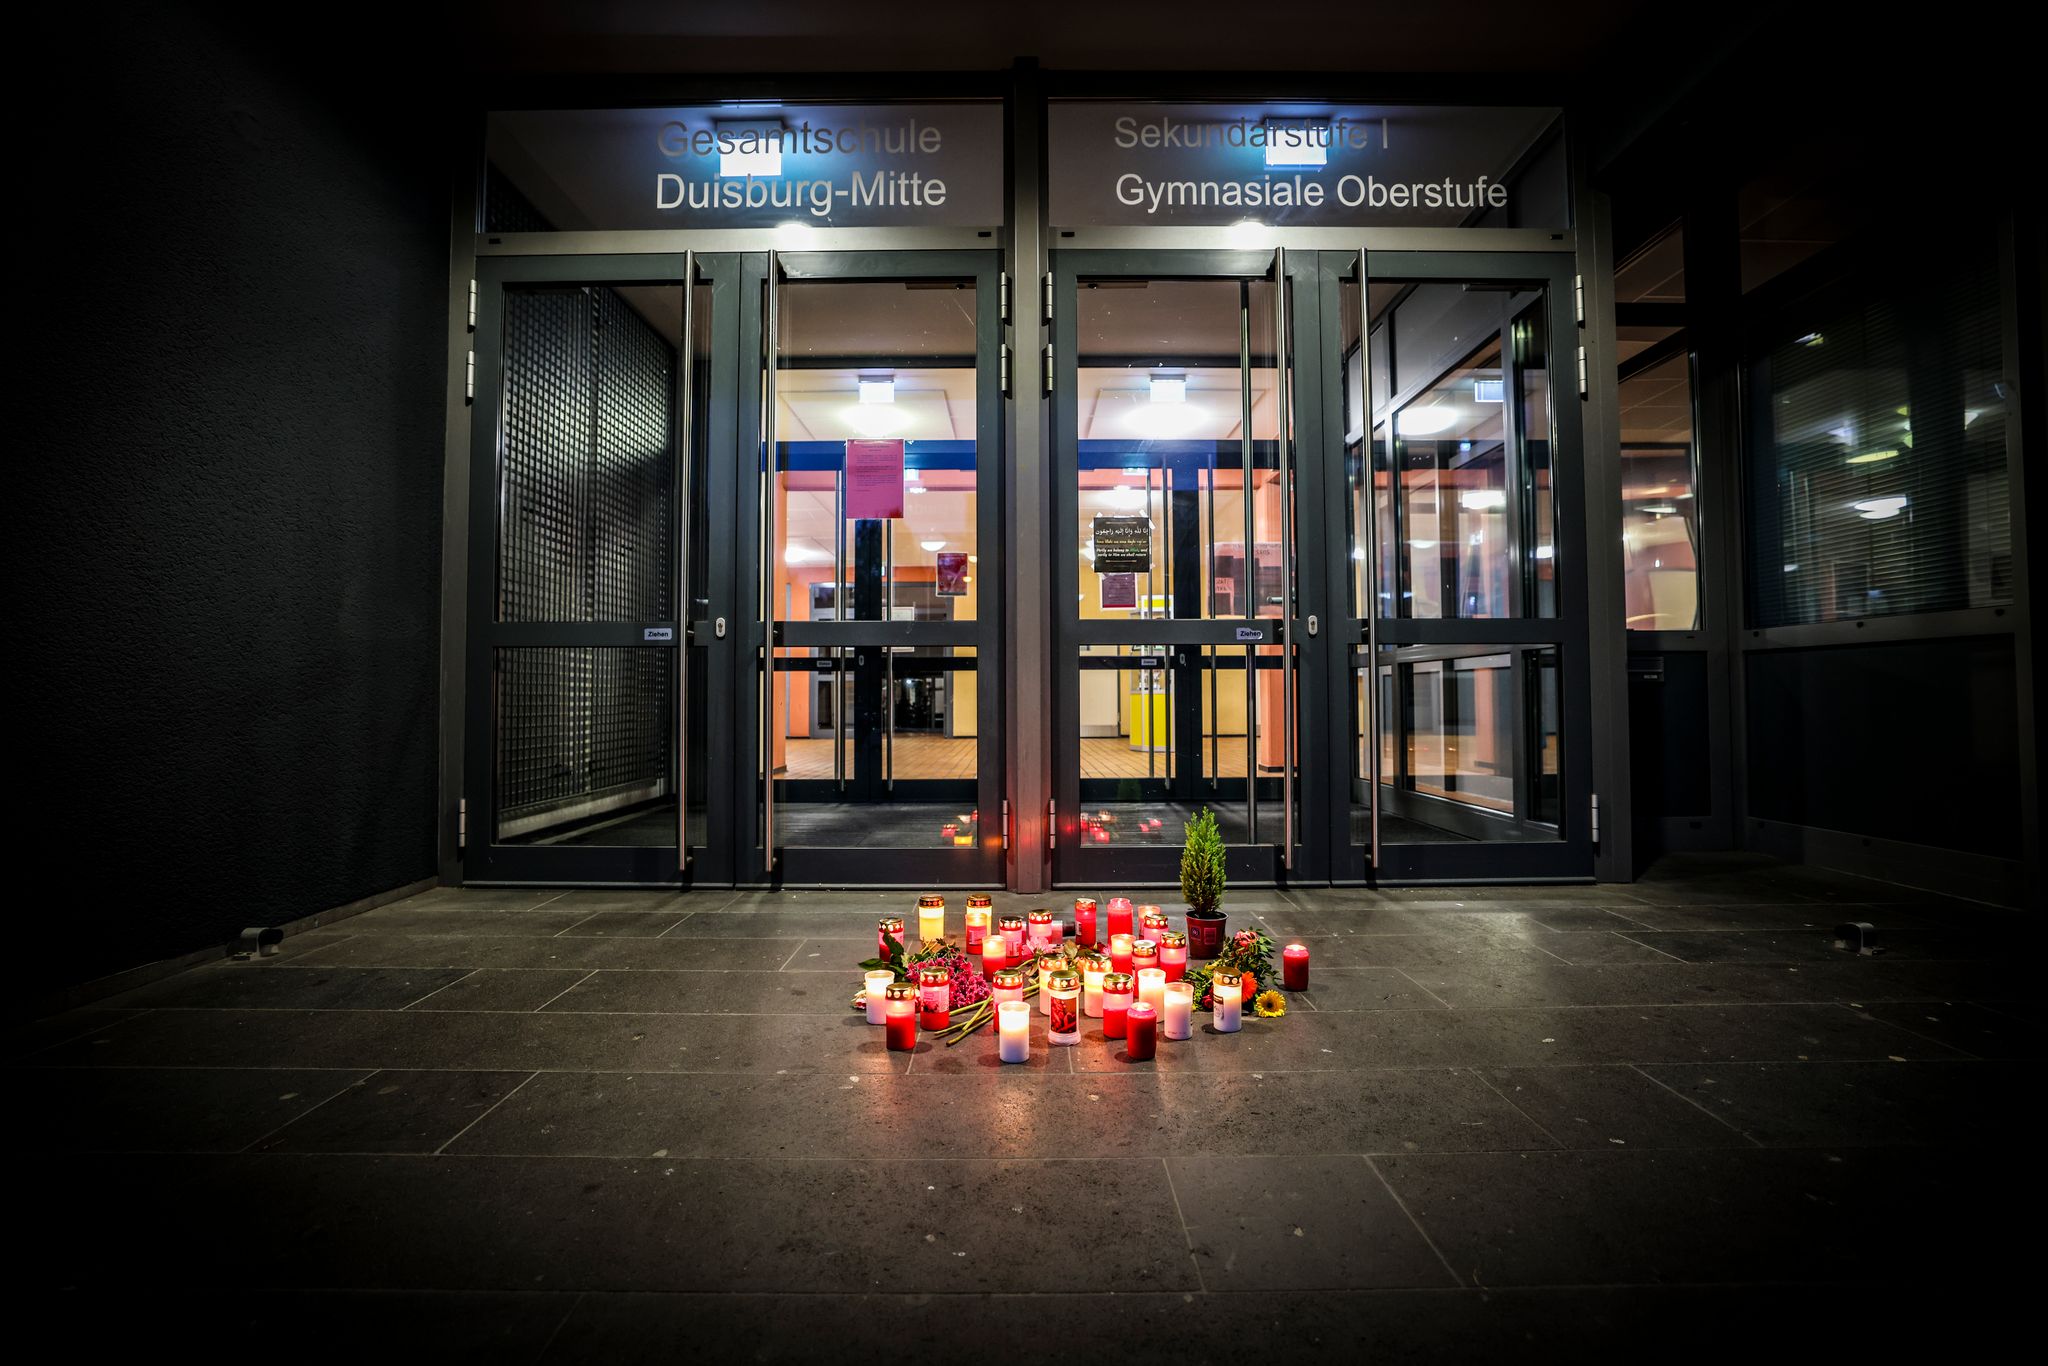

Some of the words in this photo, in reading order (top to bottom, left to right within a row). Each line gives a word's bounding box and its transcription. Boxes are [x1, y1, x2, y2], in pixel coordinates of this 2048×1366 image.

[658, 119, 942, 157] Gesamtschule
[1114, 116, 1368, 149] Sekundarstufe
[656, 171, 946, 216] Duisburg-Mitte
[1116, 173, 1325, 214] Gymnasiale
[1337, 174, 1508, 209] Oberstufe
